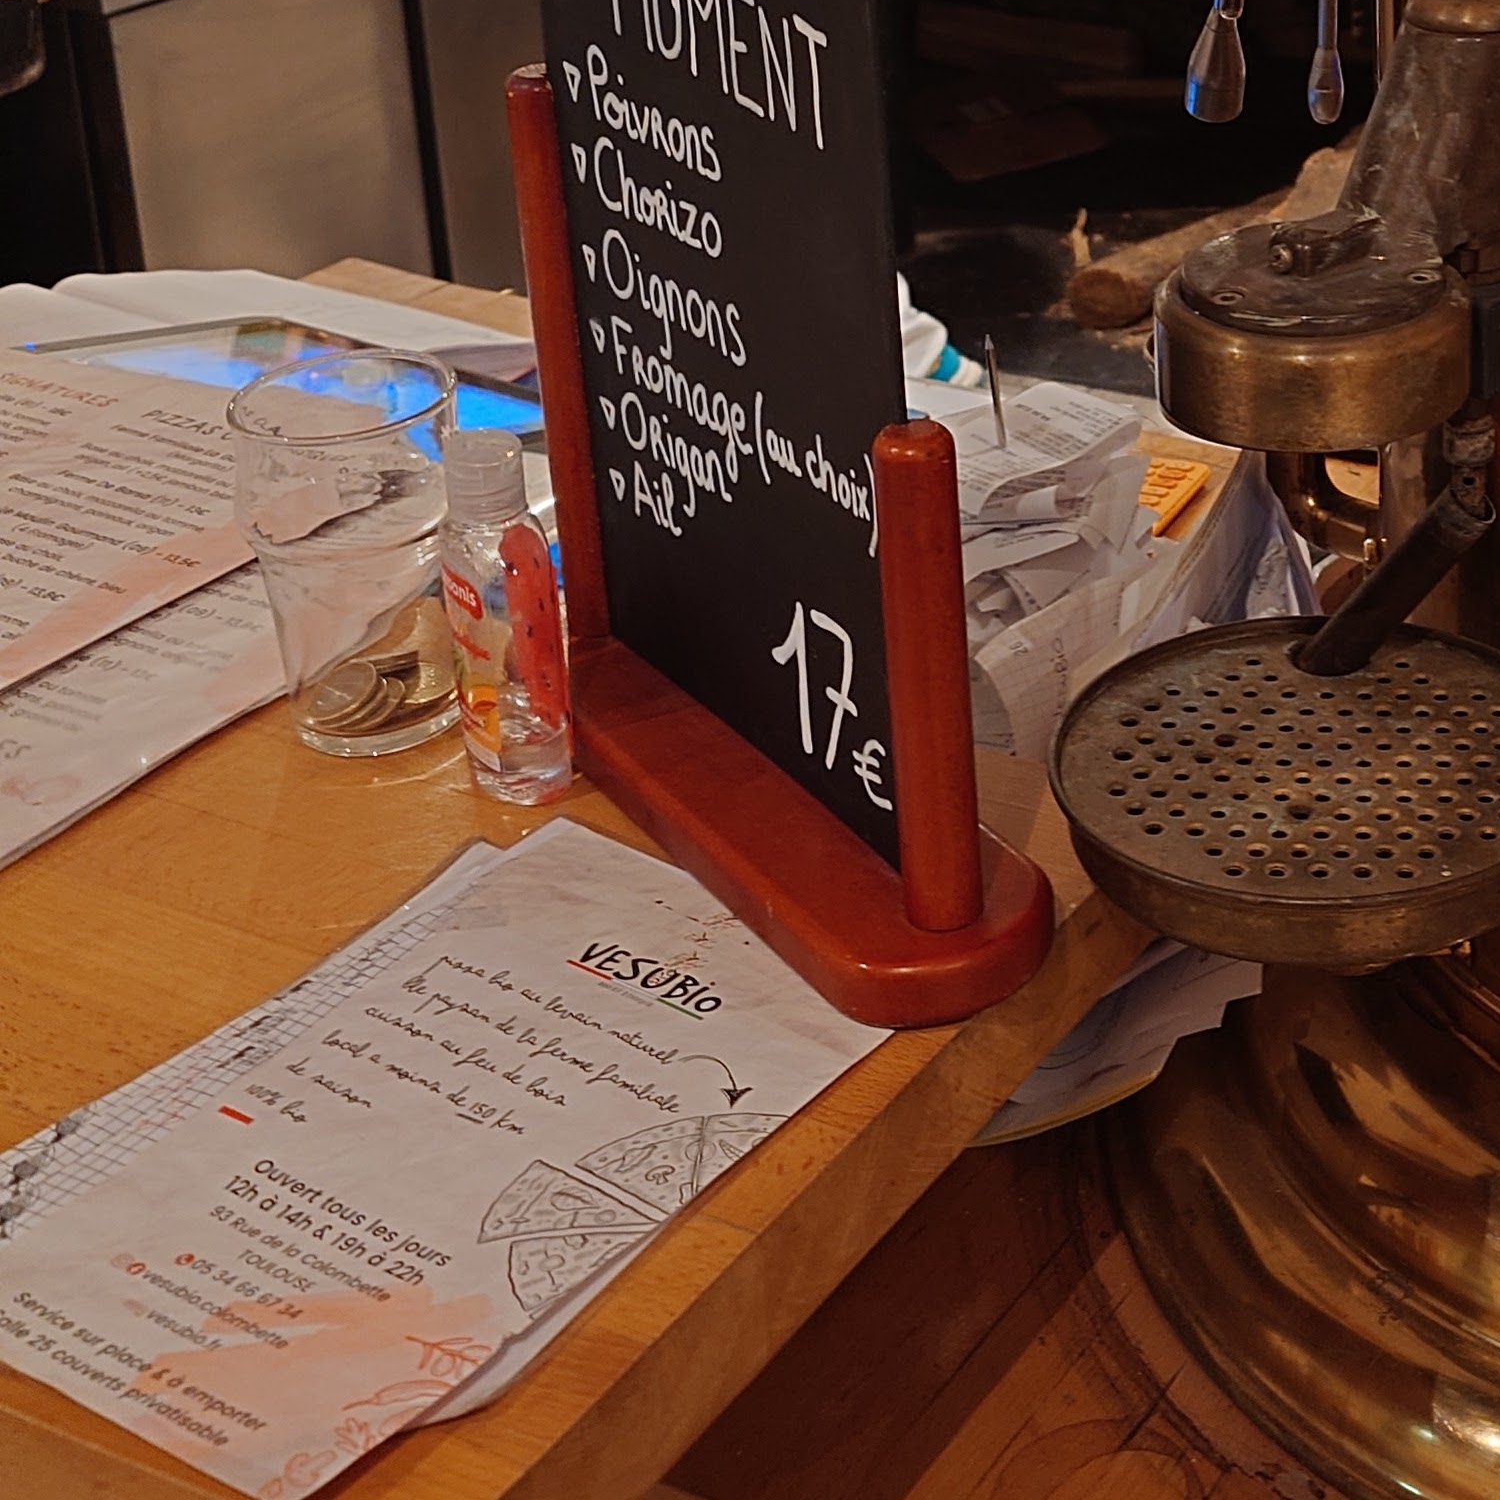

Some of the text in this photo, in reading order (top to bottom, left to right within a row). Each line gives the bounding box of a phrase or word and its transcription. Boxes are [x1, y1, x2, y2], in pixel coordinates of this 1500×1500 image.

[602, 229, 746, 367] Oignons
[141, 409, 223, 436] PIZZAS
[633, 462, 683, 537] Ail
[413, 993, 490, 1023] paysan
[496, 1016, 515, 1036] de
[517, 1028, 537, 1046] la
[529, 1039, 593, 1074] ferme
[586, 1063, 680, 1113] familiale
[489, 970, 514, 991] bio
[521, 988, 542, 1005] au
[542, 997, 602, 1030] levain
[608, 1029, 679, 1065] naturel
[244, 1084, 308, 1123] 100% bio
[286, 1057, 372, 1109] de saison
[322, 1029, 372, 1059] local
[386, 1064, 441, 1094] moins
[446, 1086, 467, 1107] de
[469, 1102, 498, 1120] 150
[490, 1109, 524, 1135] km
[440, 1039, 461, 1056] au
[453, 1048, 497, 1074] feu
[502, 1064, 523, 1085] de
[525, 1076, 567, 1106] bois
[210, 1205, 391, 1303] 93 Rue de la Colombette
[224, 1175, 425, 1287] 12h à 14h & 19h à 22h
[254, 1159, 452, 1268] Ouvert tous les jours
[191, 1259, 304, 1320] 05 34 66 67 34
[237, 1249, 318, 1293] TOULOUSE
[13, 1291, 75, 1331] Service
[73, 1326, 104, 1346] sur
[96, 1338, 152, 1373] place
[182, 1384, 267, 1432] emporter
[146, 1310, 223, 1352] vesubio.fr
[27, 1334, 57, 1352] 25
[51, 1348, 128, 1393] couverts
[119, 1385, 229, 1447] privatisable
